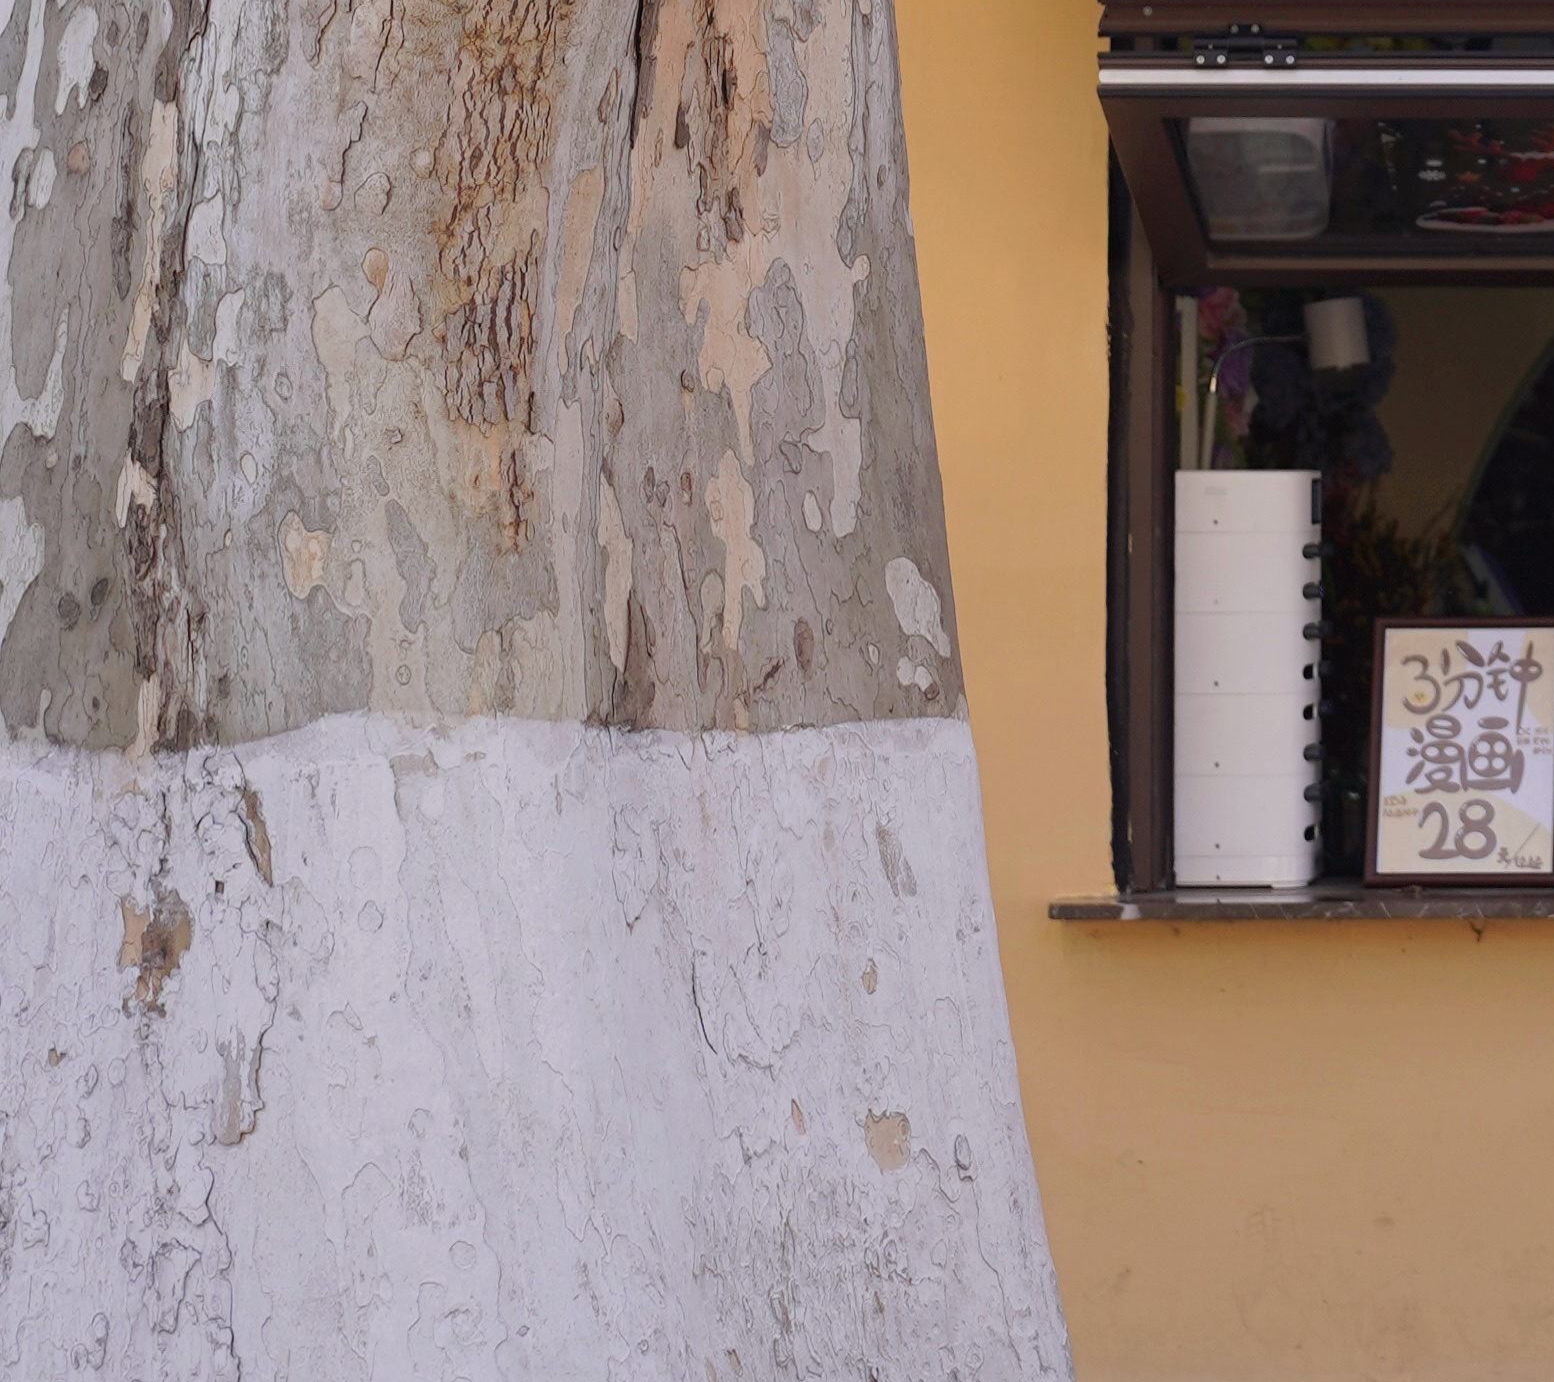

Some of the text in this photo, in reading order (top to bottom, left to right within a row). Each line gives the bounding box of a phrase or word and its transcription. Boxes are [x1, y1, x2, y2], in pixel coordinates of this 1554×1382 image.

[1401, 639, 1543, 735] 3分钟
[1405, 713, 1526, 794] 漫画
[1417, 797, 1498, 860] 28
